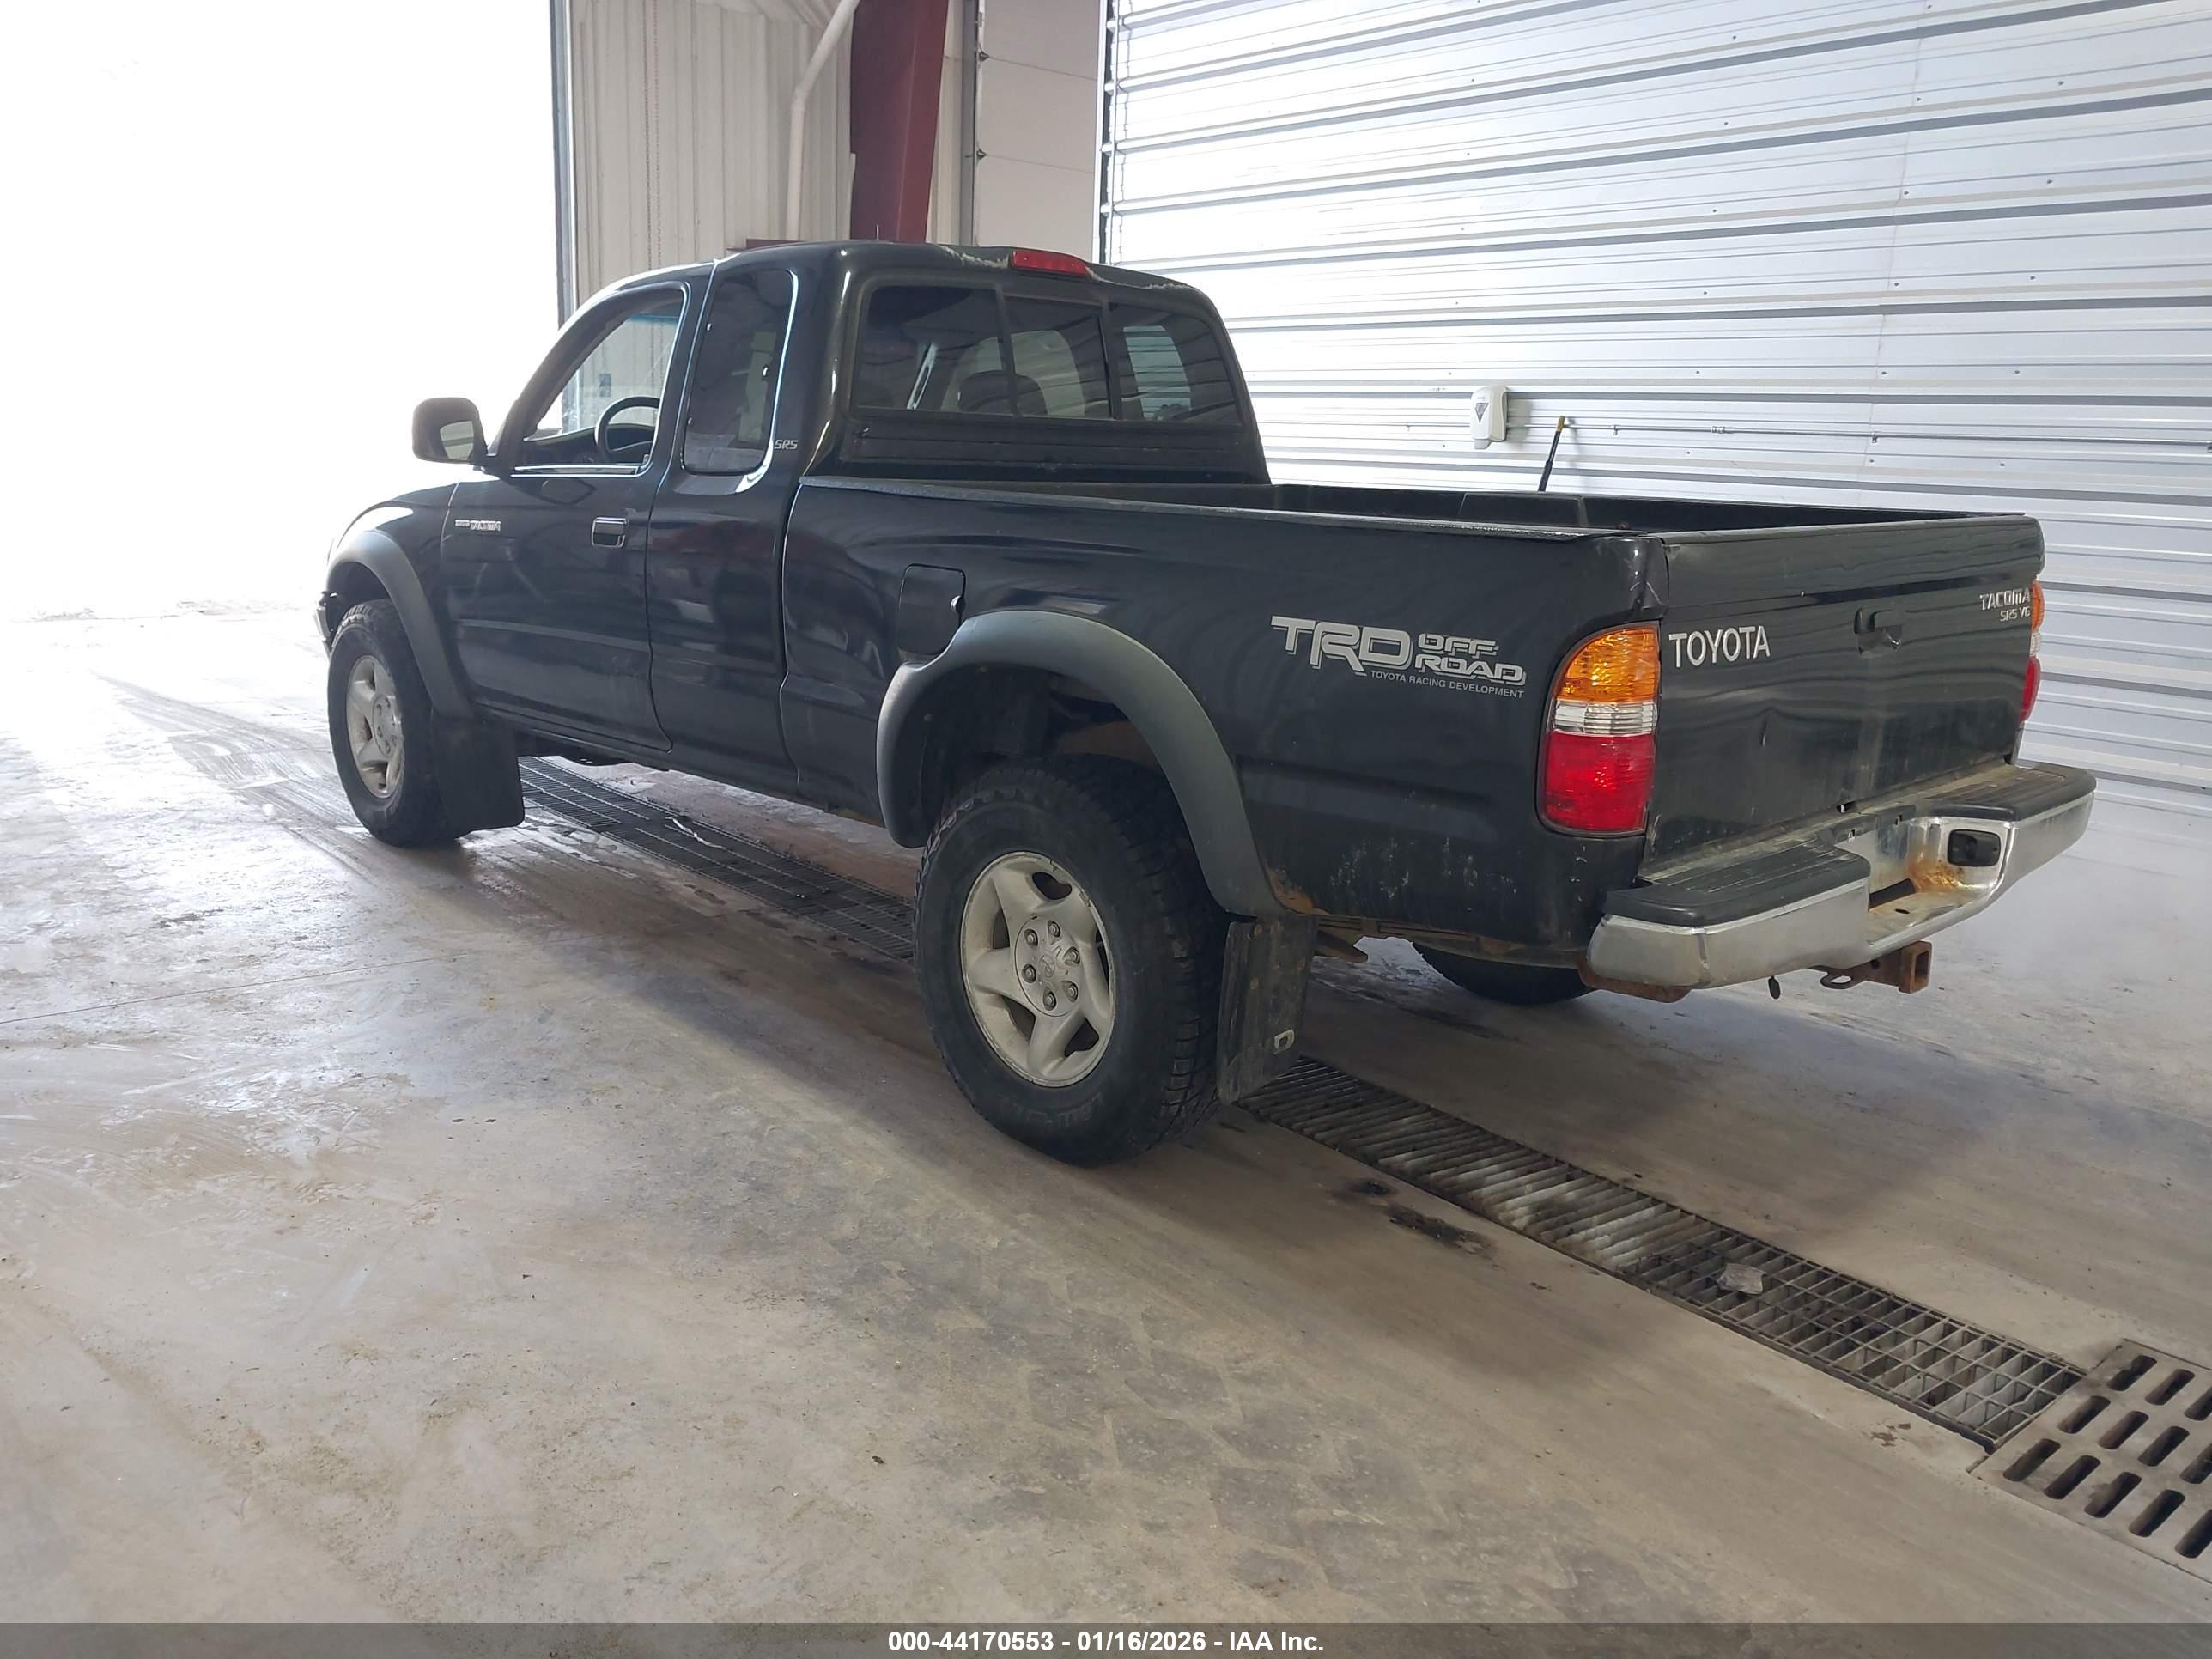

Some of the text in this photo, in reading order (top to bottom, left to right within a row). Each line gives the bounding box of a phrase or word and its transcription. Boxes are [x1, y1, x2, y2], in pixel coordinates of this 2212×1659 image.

[1979, 587, 2031, 611] TACOMA
[1271, 615, 1413, 676] TRD
[1418, 632, 1499, 659] OFF
[1668, 625, 1771, 668] TOYOTA
[1370, 670, 1525, 699] TOYOTA RACING DEVELOPMENT
[1414, 653, 1527, 686] ROAD
